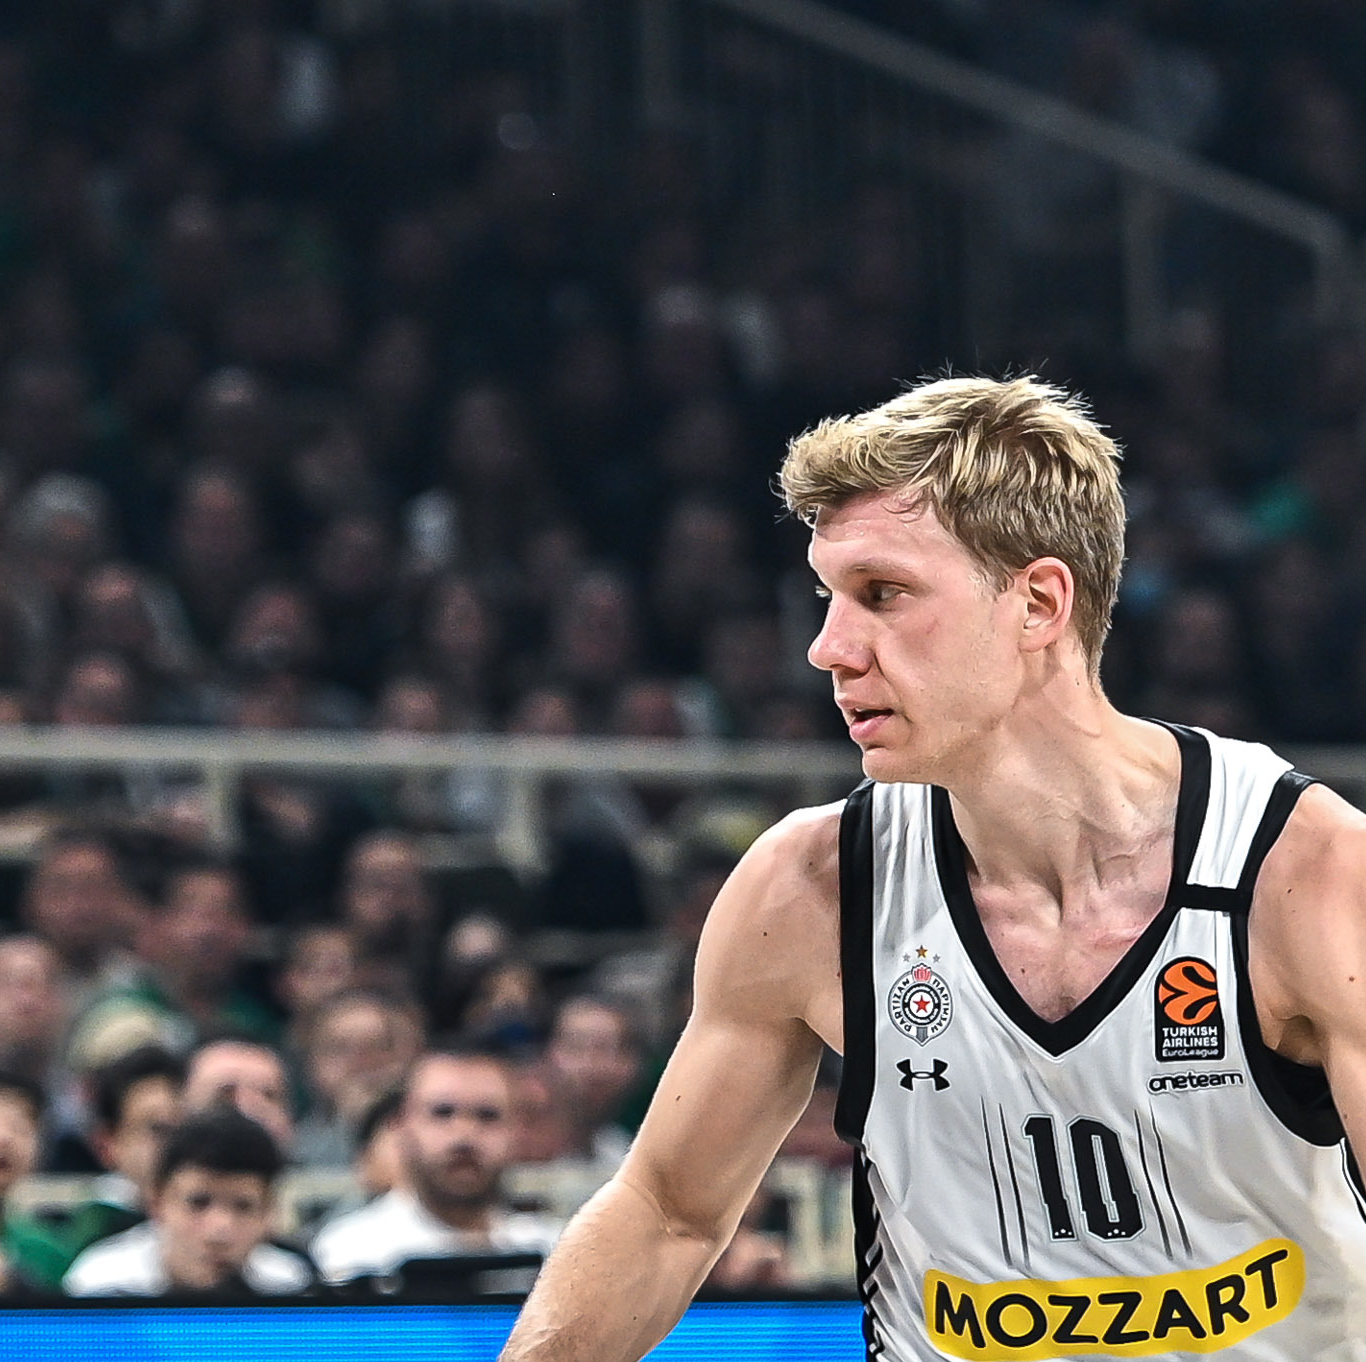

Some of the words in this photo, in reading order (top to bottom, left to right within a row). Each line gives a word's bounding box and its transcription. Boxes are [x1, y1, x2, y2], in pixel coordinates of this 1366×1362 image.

[1162, 1026, 1218, 1037] TURKISH
[1162, 1037, 1218, 1048] AIRLINES
[1149, 1072, 1244, 1092] oneteam
[1022, 1114, 1145, 1241] 10
[934, 1248, 1289, 1350] MOZZART
